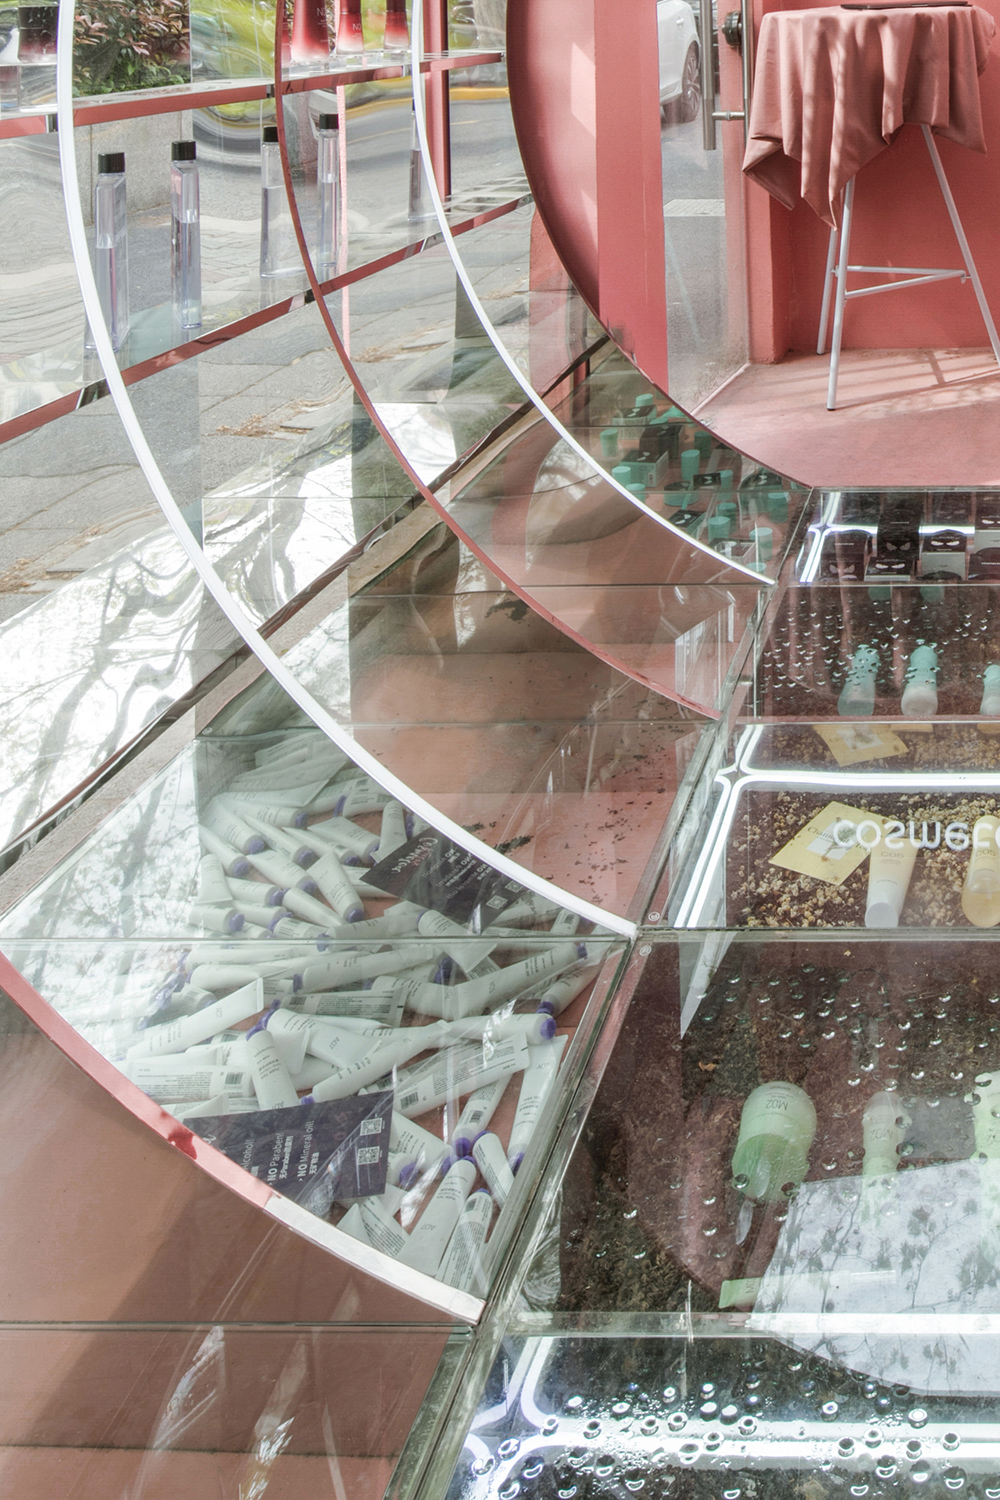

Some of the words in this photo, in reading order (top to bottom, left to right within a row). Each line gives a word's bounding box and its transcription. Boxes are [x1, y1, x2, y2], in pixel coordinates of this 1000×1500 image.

[766, 1099, 789, 1111] M02
[306, 1120, 314, 1133] oil!
[269, 1132, 284, 1167] Paraben!
[300, 1133, 312, 1163] Mineral
[267, 1167, 278, 1181] NO
[297, 1163, 308, 1177] NO
